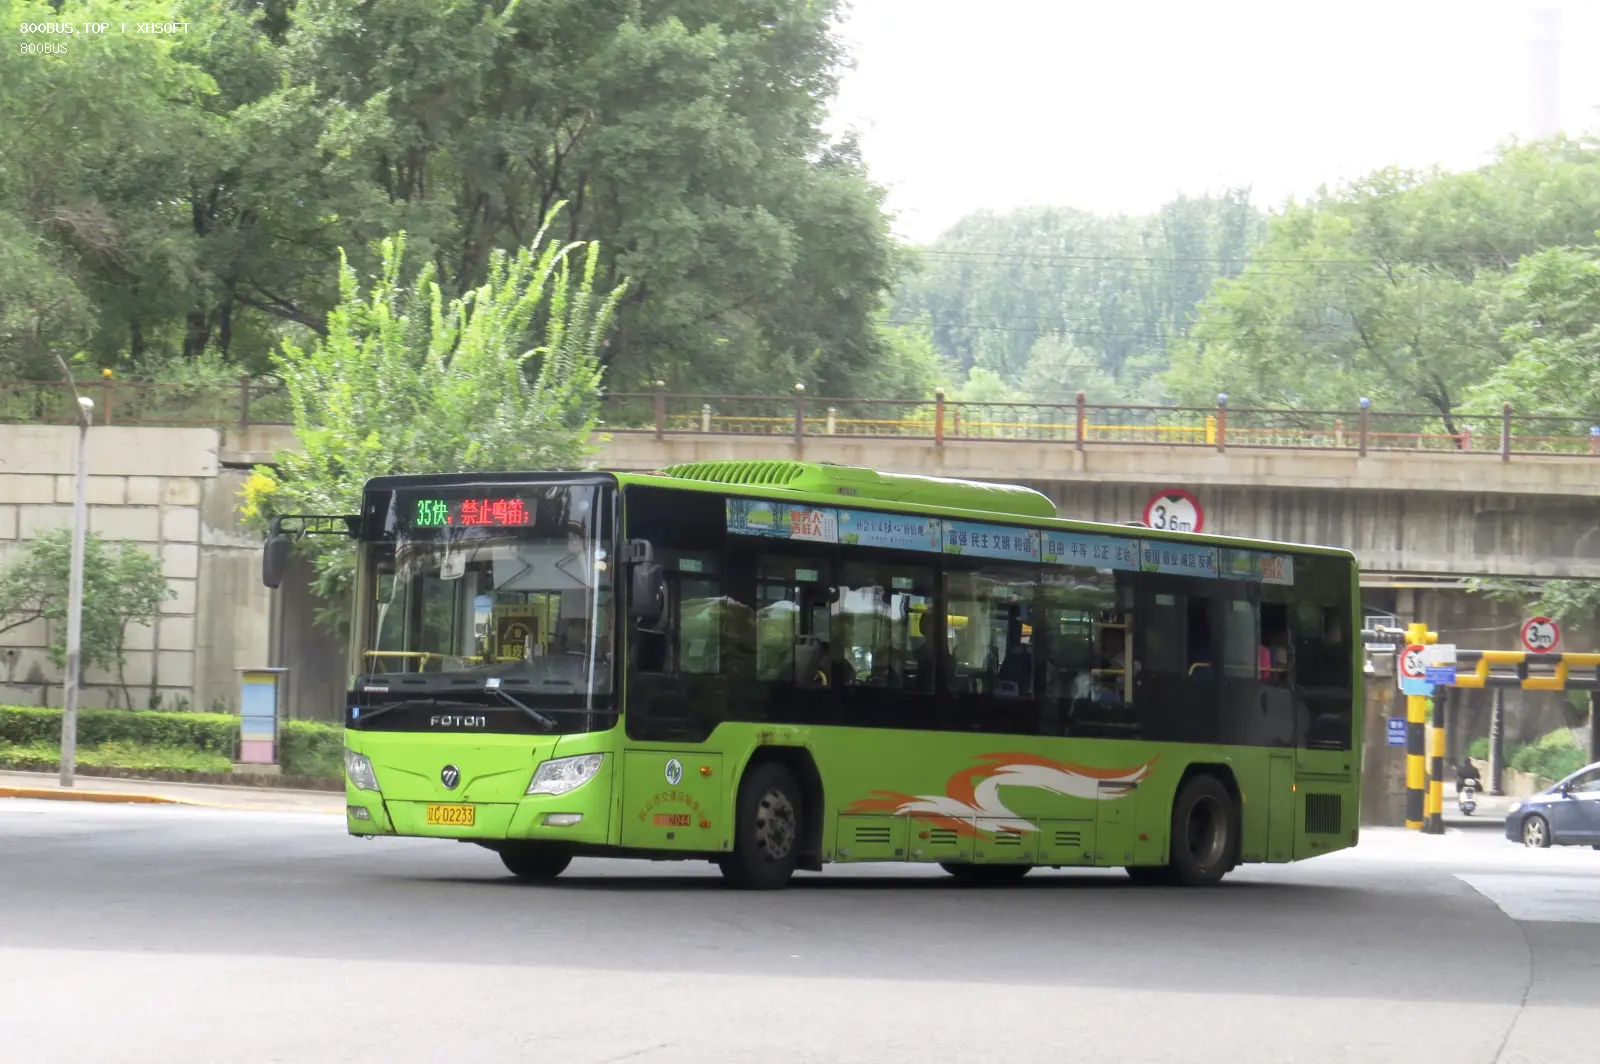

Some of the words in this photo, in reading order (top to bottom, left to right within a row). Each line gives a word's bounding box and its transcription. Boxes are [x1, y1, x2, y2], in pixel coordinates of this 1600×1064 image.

[949, 530, 967, 546] 富强
[971, 532, 989, 548] 民主
[993, 534, 1010, 550] 文明
[1014, 536, 1032, 552] 和谐
[1048, 540, 1065, 556] 自由
[1071, 542, 1088, 558] 平等
[1093, 545, 1109, 560] 公正
[1115, 546, 1131, 561] 法治
[1528, 626, 1552, 643] 3m
[430, 715, 486, 727] FOTON
